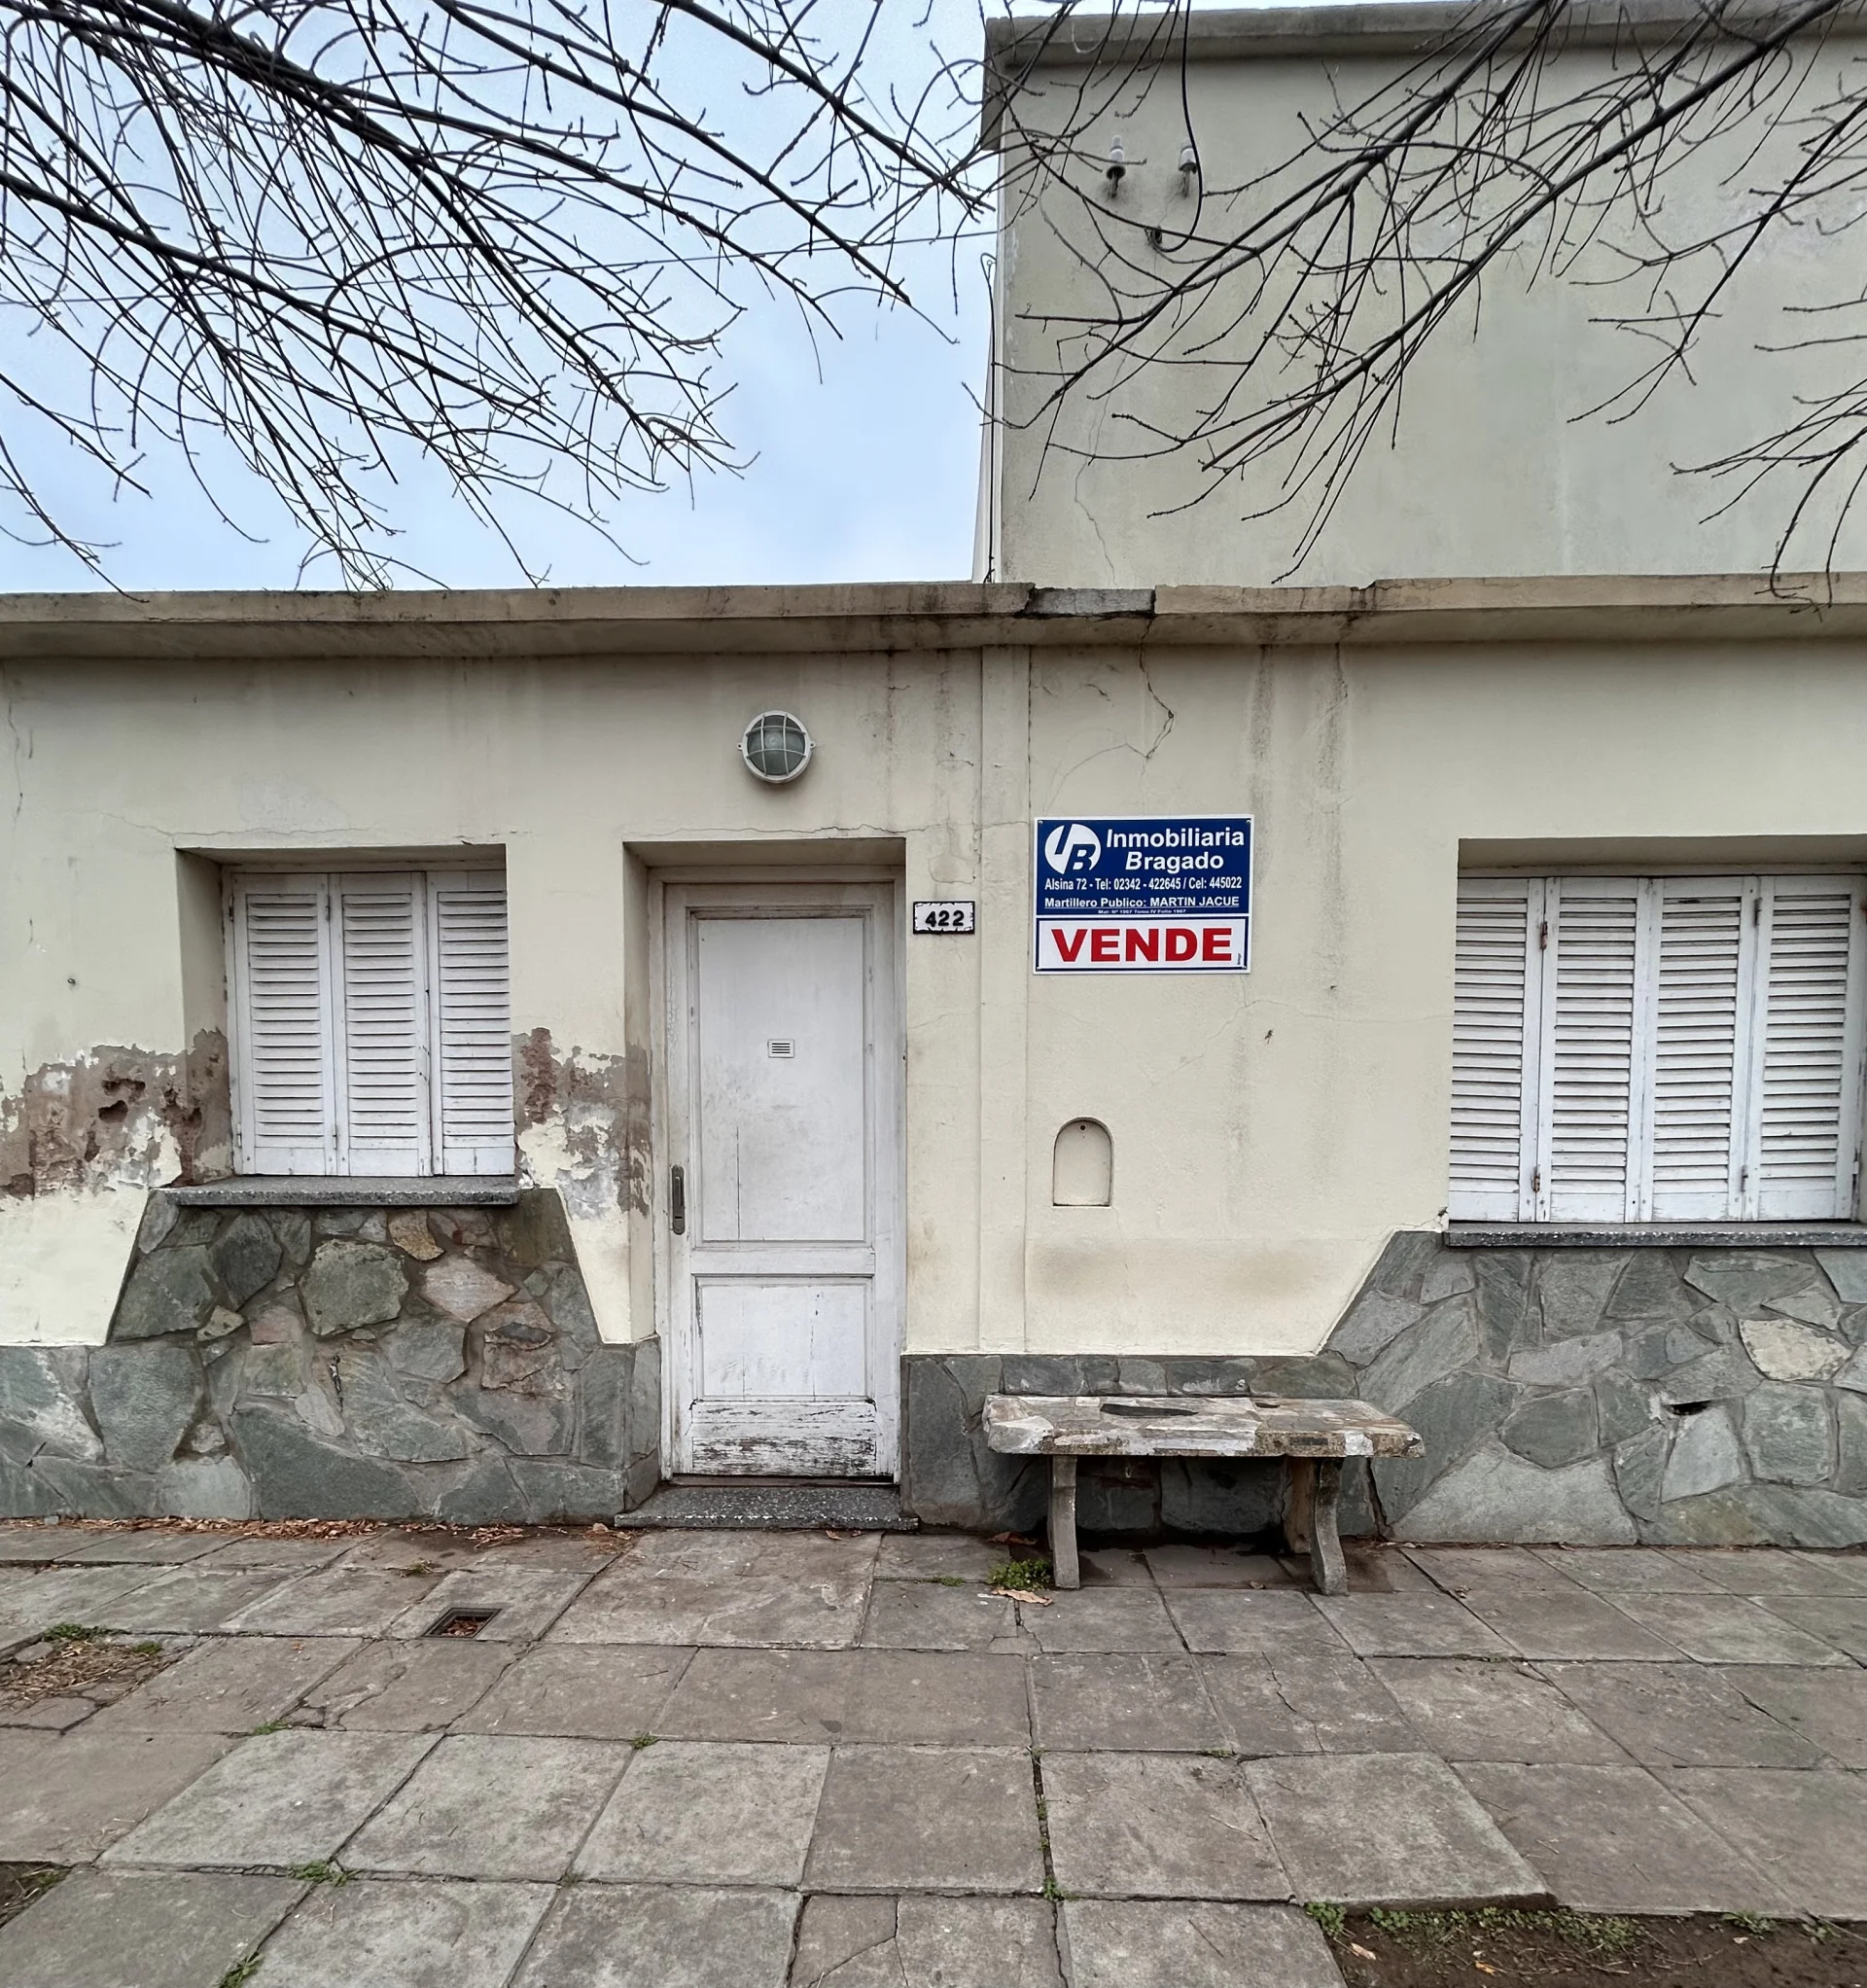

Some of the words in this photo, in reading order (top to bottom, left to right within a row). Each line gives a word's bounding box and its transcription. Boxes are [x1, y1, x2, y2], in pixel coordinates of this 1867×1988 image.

[1106, 827, 1245, 848] Inmobiliaria
[1125, 851, 1224, 874] Bragado
[1044, 877, 1074, 891] Alsina
[1075, 877, 1087, 891] 72
[1095, 877, 1111, 891] Tel:
[1113, 877, 1141, 891] 02342
[1148, 877, 1181, 890] 422645
[1188, 876, 1208, 890] Cel:
[1209, 876, 1243, 889] 445022
[1044, 897, 1098, 907] Martillero
[1100, 897, 1147, 907] Publico:
[1149, 896, 1196, 906] MARTIN
[1198, 896, 1240, 906] JACUE
[925, 909, 965, 928] 422
[1051, 928, 1232, 962] VENDE
